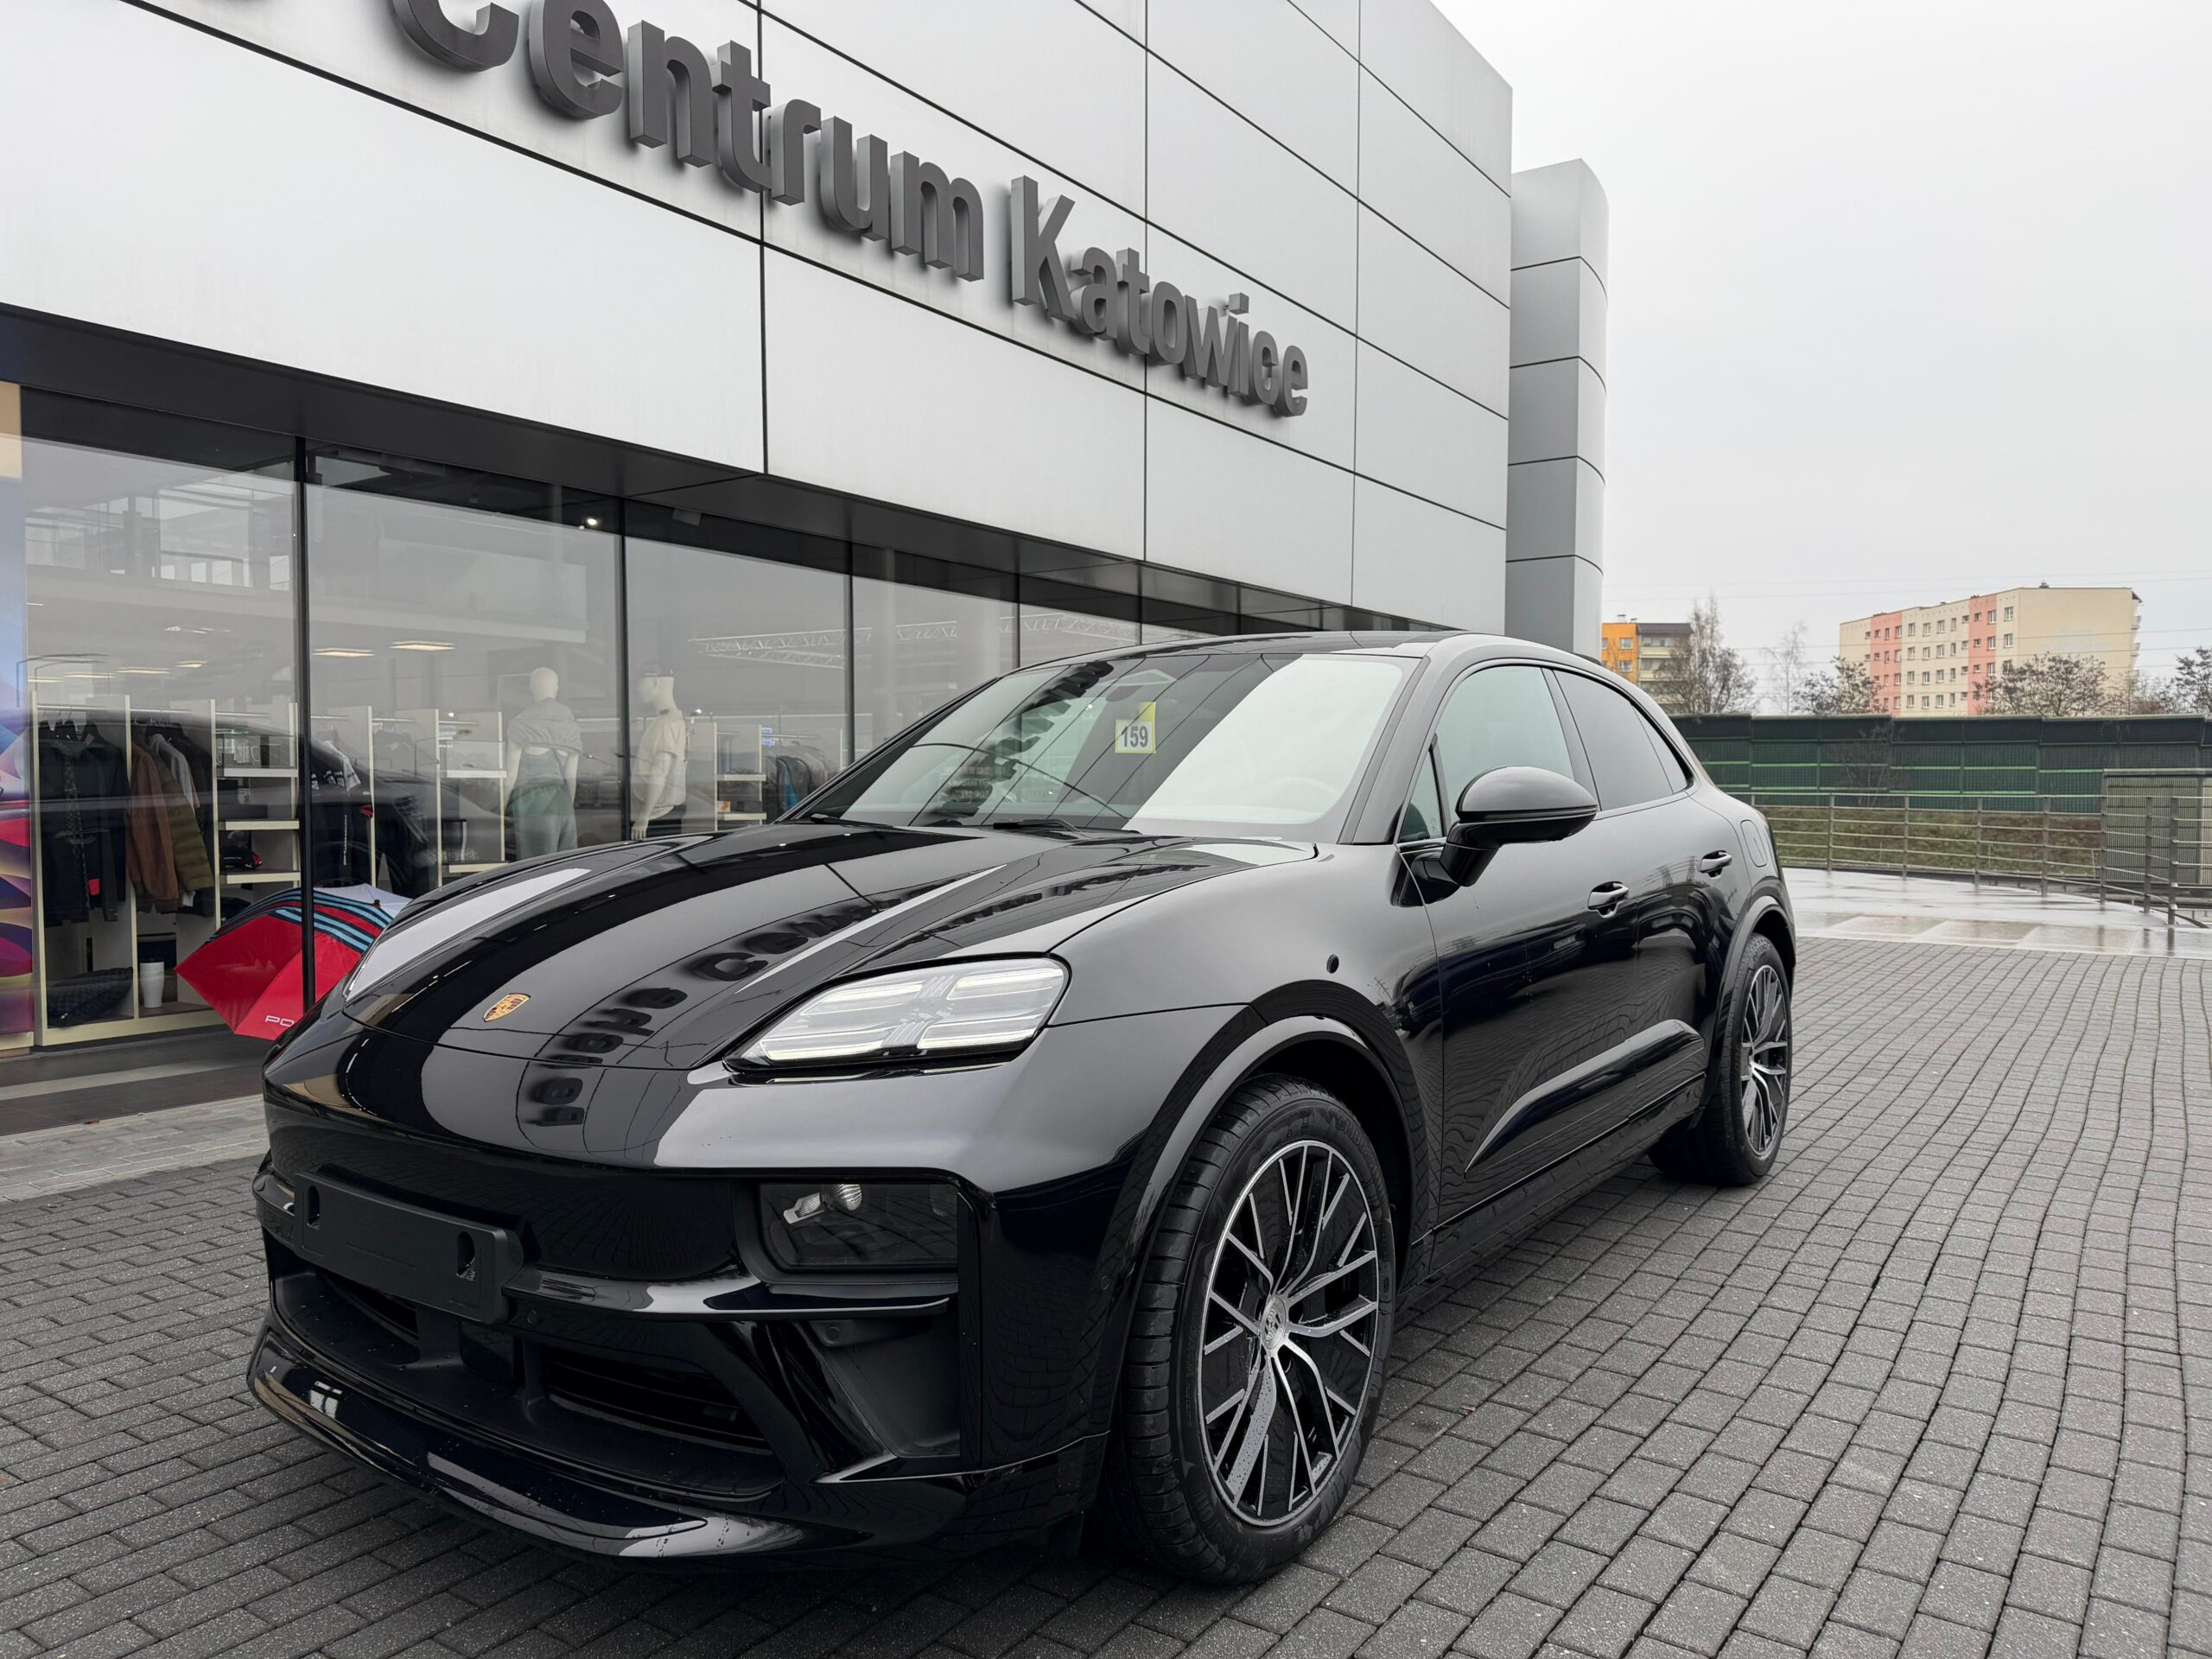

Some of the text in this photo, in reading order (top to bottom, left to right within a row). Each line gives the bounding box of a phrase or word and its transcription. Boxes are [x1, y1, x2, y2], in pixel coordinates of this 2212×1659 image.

[1011, 175, 1308, 417] Katowice
[1122, 725, 1148, 747] 159
[264, 1014, 296, 1027] PO
